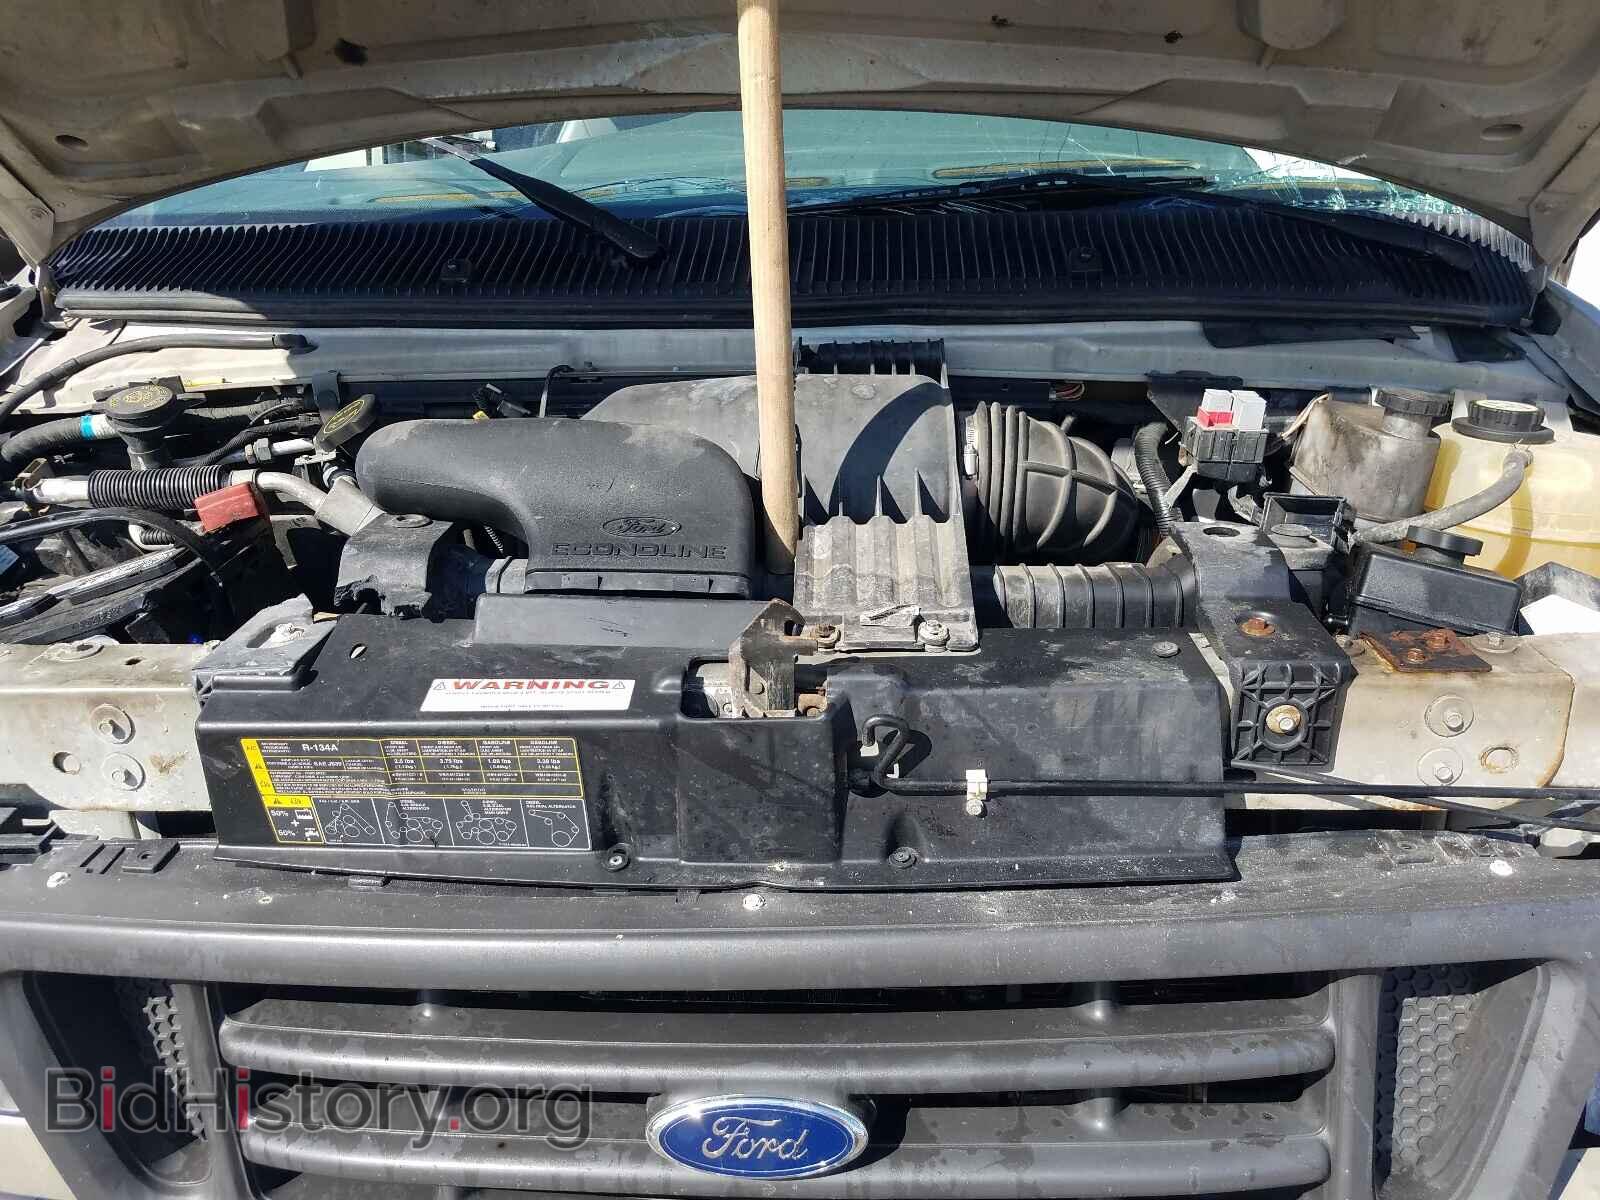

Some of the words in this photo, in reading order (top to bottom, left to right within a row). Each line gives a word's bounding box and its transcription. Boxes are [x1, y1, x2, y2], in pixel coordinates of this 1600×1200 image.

[618, 519, 667, 534] Ford
[551, 543, 728, 560] ECONOLINE
[453, 680, 610, 690] WARNING
[301, 743, 339, 752] R-134A
[702, 1116, 810, 1160] Ford
